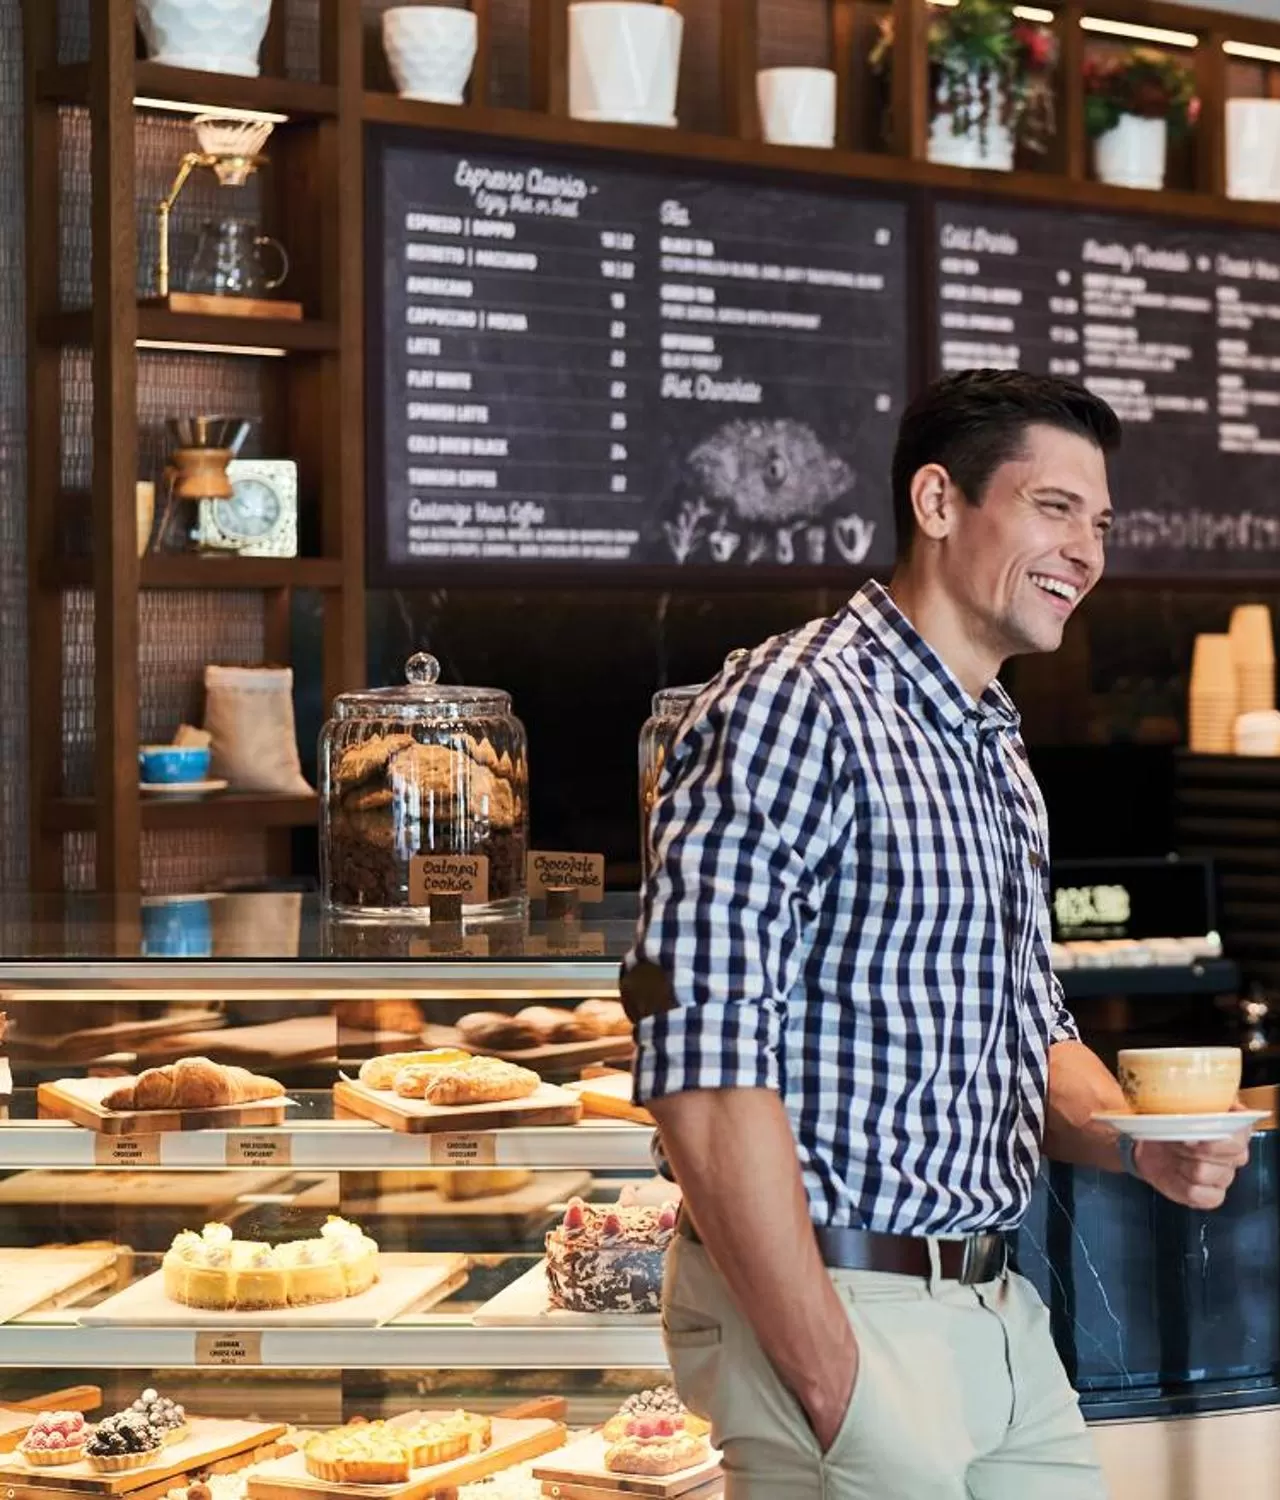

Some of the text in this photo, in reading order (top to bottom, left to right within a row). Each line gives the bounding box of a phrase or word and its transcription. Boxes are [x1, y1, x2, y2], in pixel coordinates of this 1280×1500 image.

[422, 859, 479, 880] Oatmeal
[534, 856, 596, 873] Chocolate
[424, 877, 473, 892] Cookie
